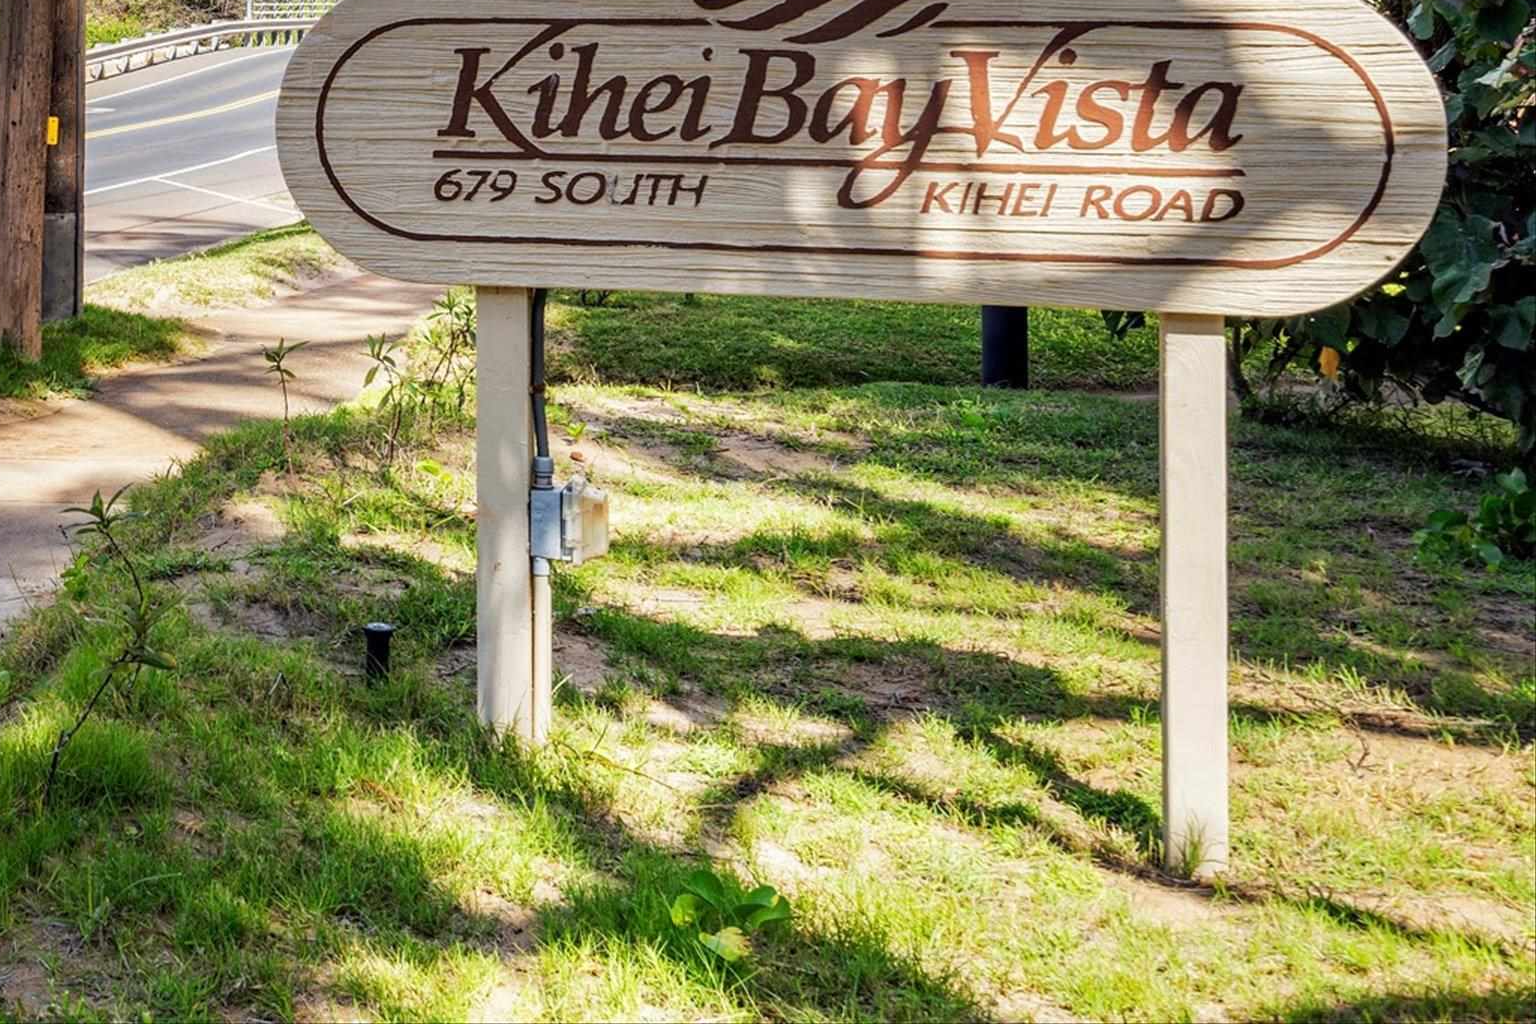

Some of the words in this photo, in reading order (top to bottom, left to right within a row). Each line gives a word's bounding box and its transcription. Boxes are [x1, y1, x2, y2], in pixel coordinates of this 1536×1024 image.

[436, 22, 712, 155] Kihei
[708, 48, 952, 210] Bay
[949, 24, 1245, 158] Vista
[433, 168, 517, 203] 679
[534, 170, 712, 208] SOUTH
[919, 181, 1057, 218] KIHEI
[1079, 184, 1246, 223] ROAD
